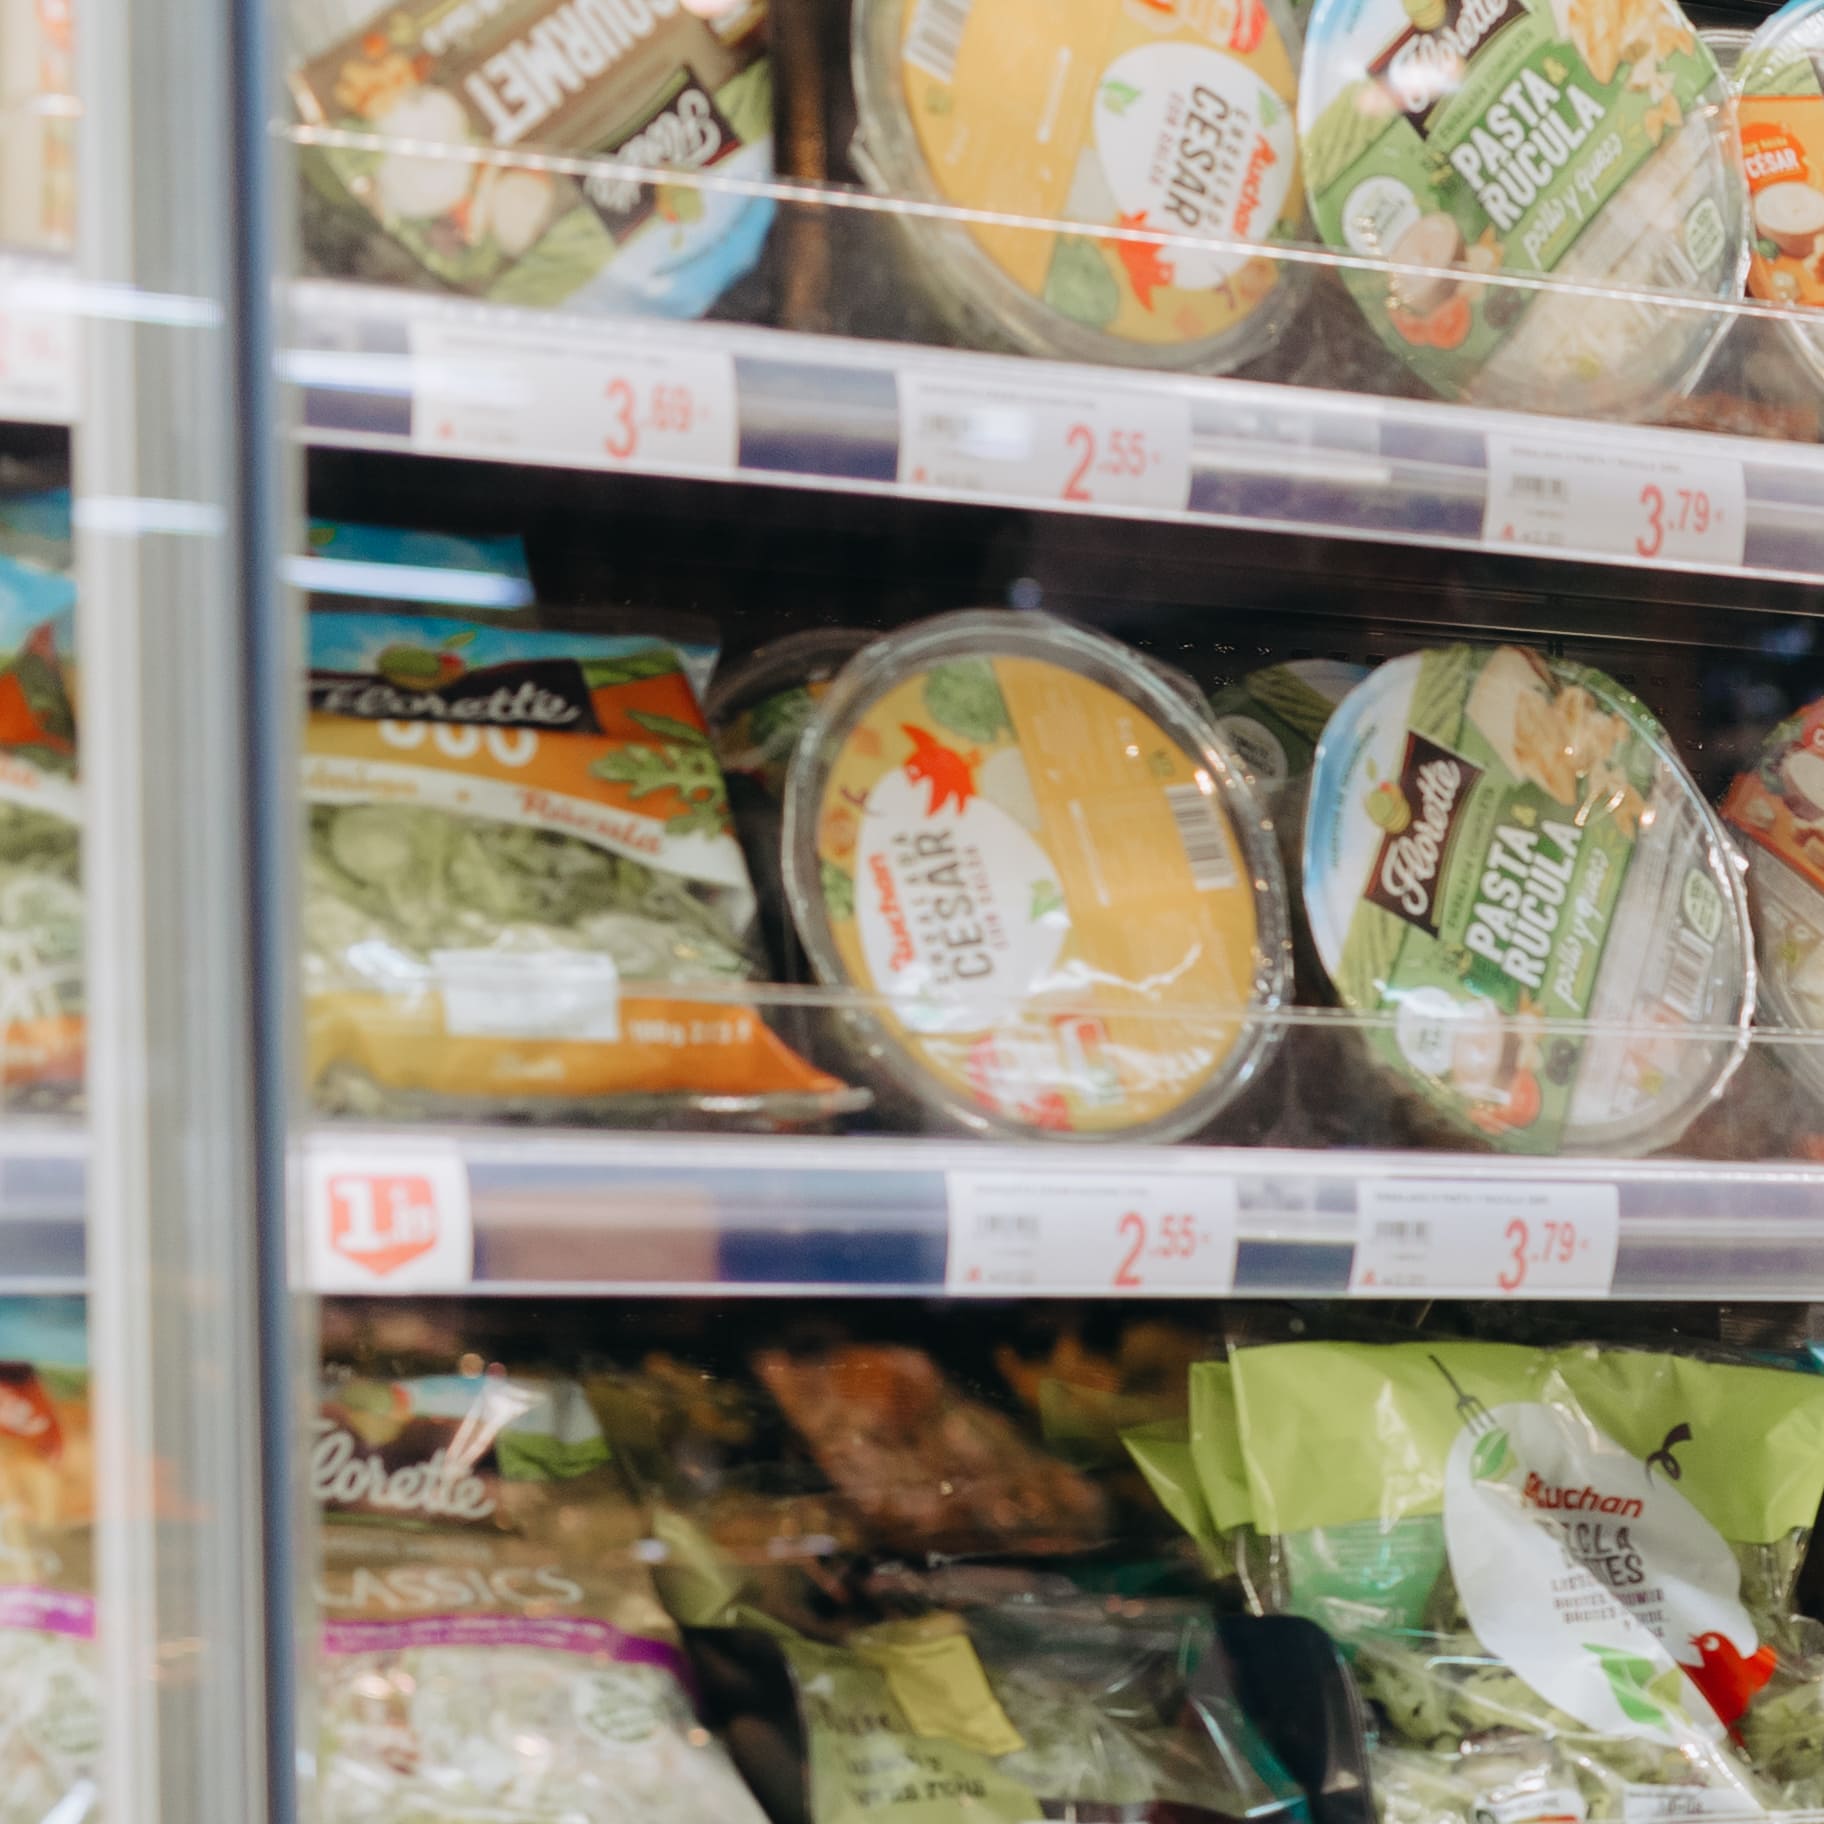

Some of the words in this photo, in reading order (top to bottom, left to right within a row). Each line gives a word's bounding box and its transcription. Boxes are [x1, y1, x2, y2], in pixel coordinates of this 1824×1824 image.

[1171, 84, 1219, 230] CESAR
[1449, 67, 1560, 192] PASTA
[1062, 424, 1146, 503] 2.55
[1636, 484, 1711, 557] 3.79
[1379, 757, 1462, 916] Florette
[935, 825, 998, 986] CESAR
[1465, 822, 1539, 965] PASTA
[1113, 1212, 1196, 1288] 2.55
[1498, 1218, 1575, 1292] 3.79
[310, 1430, 497, 1522] lorette
[1522, 1471, 1644, 1519] Auchan
[310, 1565, 586, 1606] LASSICS
